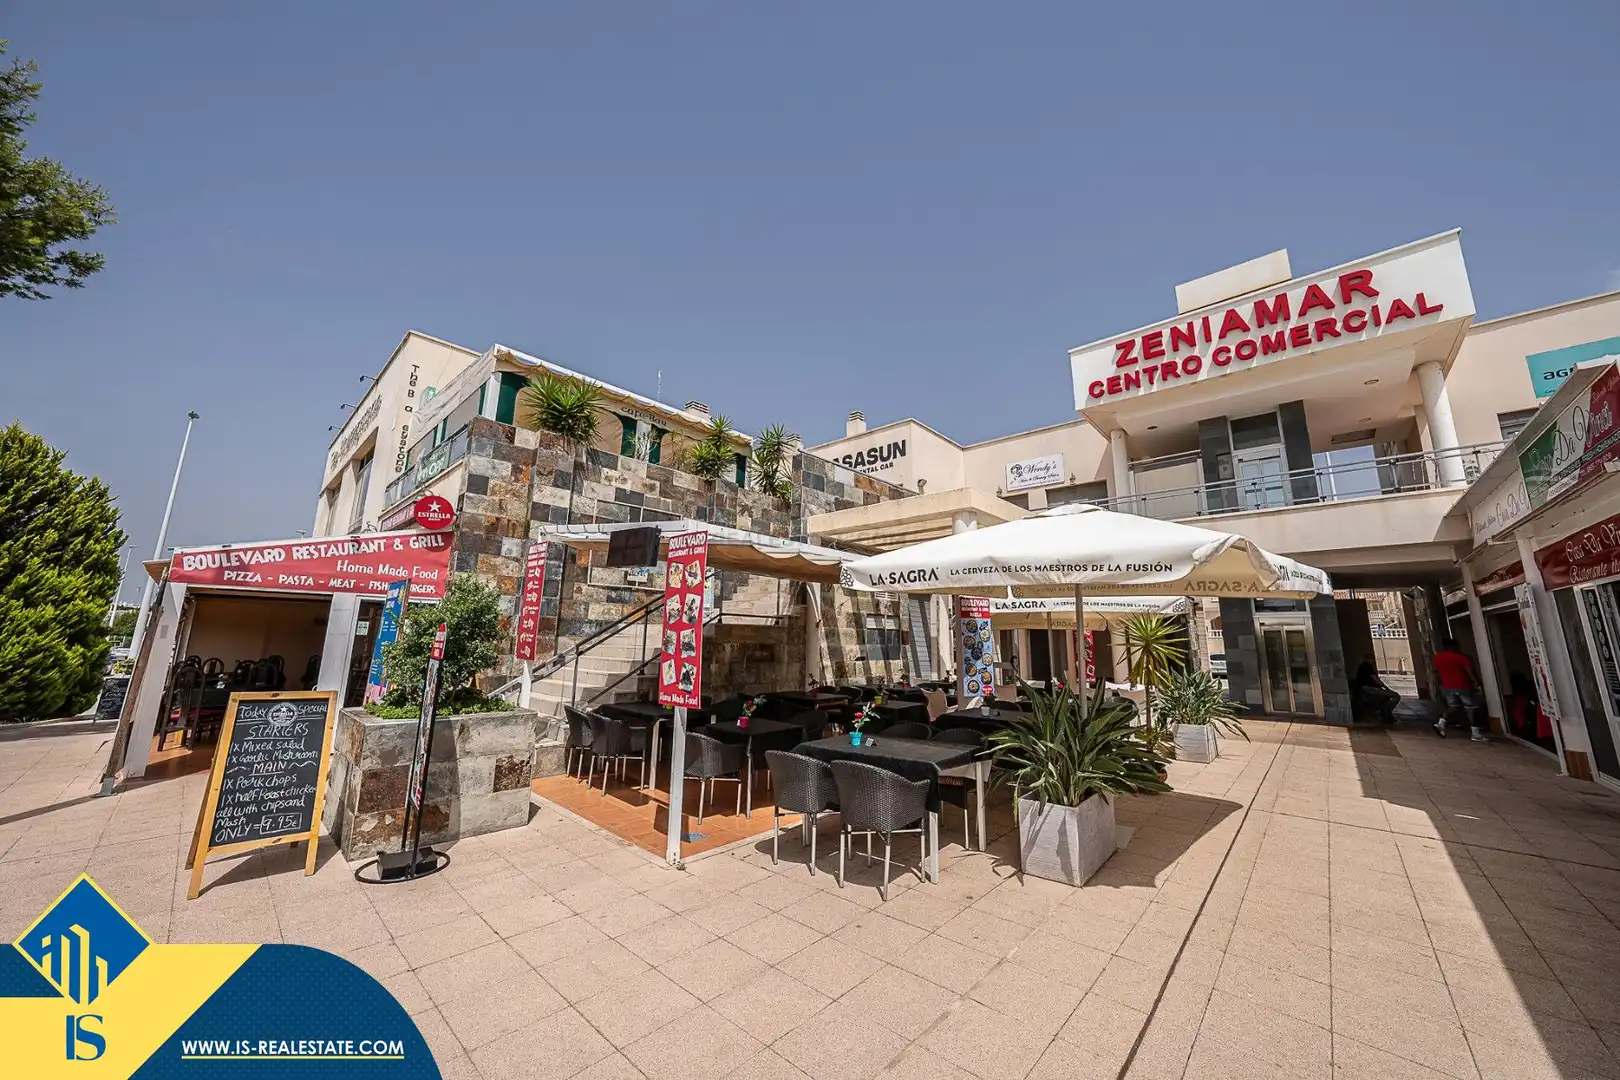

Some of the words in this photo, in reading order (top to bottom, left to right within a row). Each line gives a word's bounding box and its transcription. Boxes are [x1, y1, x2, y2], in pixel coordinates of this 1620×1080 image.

[1115, 268, 1380, 368] ZENIAMAR
[1088, 353, 1201, 399] CENTRO
[1212, 291, 1444, 367] COMERCIAL
[880, 462, 894, 470] CAR
[418, 511, 451, 519] ESTRELLA
[669, 532, 706, 550] BOULEVARD
[182, 547, 286, 571] BOULEVARD
[292, 539, 387, 560] RESTAURANT
[393, 537, 404, 551] &
[409, 534, 445, 548] GRILL
[378, 563, 409, 577] Made
[412, 566, 438, 580] Food
[962, 566, 1000, 575] CERVEZA
[1002, 565, 1012, 573] DE
[1015, 564, 1032, 573] LOS
[1035, 563, 1088, 572] MAESTROS
[1091, 564, 1105, 572] DE
[1108, 564, 1122, 572] LA
[1126, 561, 1173, 572] FUSIÓN
[223, 570, 263, 583] PIZZA
[278, 574, 314, 586] PASTA
[328, 578, 356, 589] MEAT
[368, 581, 388, 591] FISH
[239, 705, 268, 719] Today
[248, 722, 309, 739] STARTERS
[252, 761, 287, 775] MAIN
[215, 822, 253, 843] ONLY
